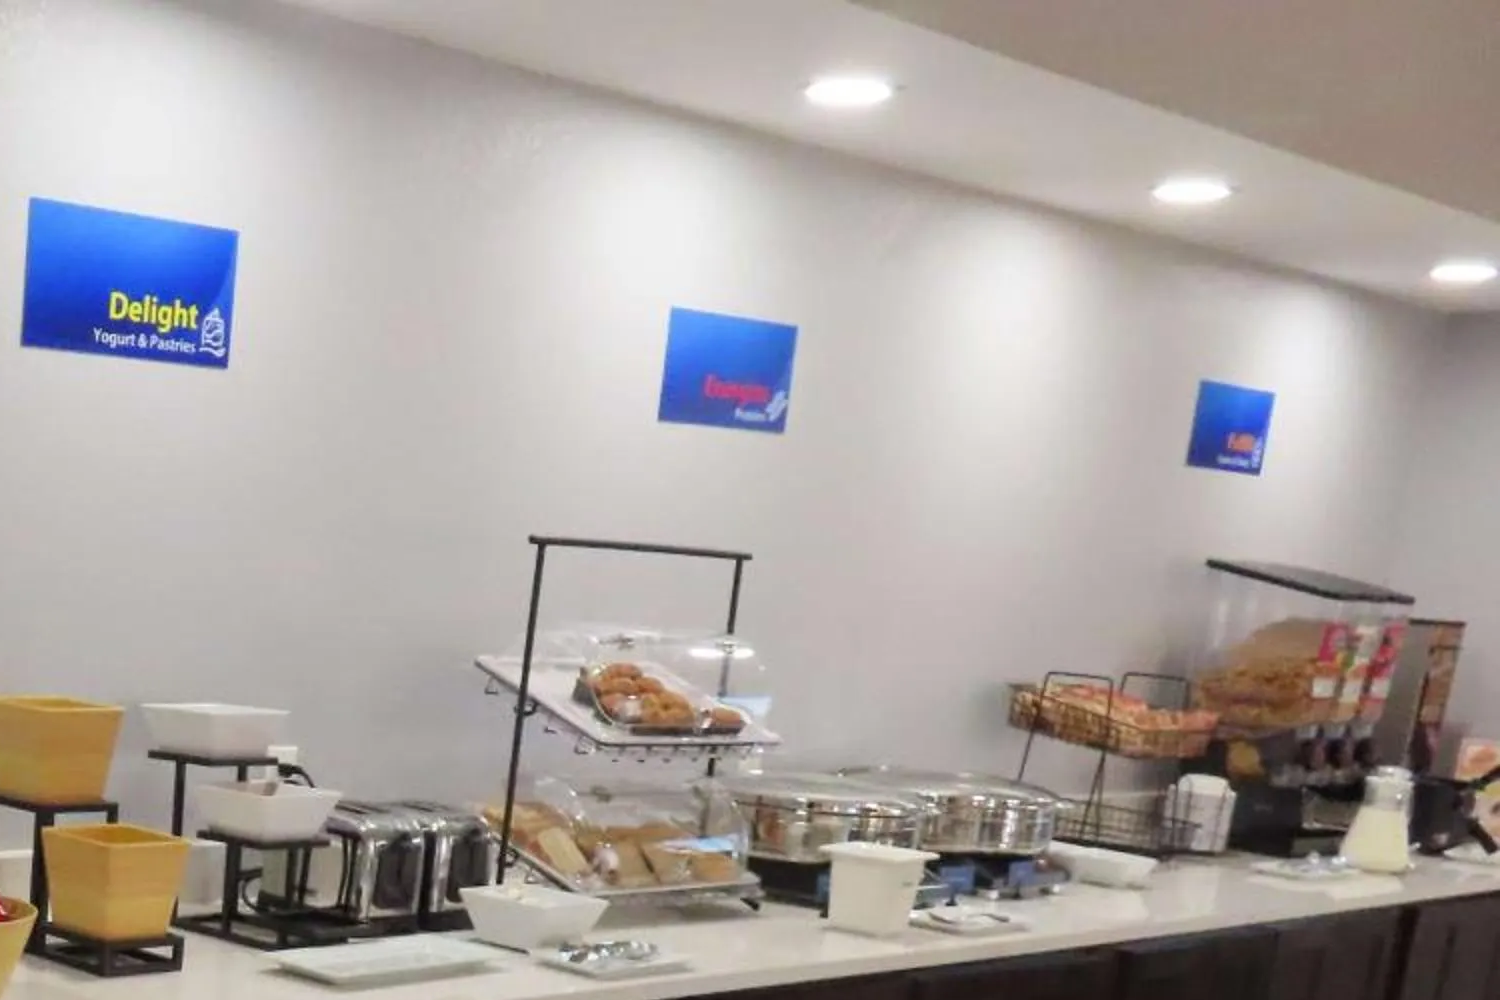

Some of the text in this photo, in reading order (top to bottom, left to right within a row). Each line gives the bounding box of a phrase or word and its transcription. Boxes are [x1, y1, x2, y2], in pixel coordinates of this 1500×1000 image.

[109, 290, 198, 333] Delight
[93, 327, 197, 353] Yogurt & Pastries
